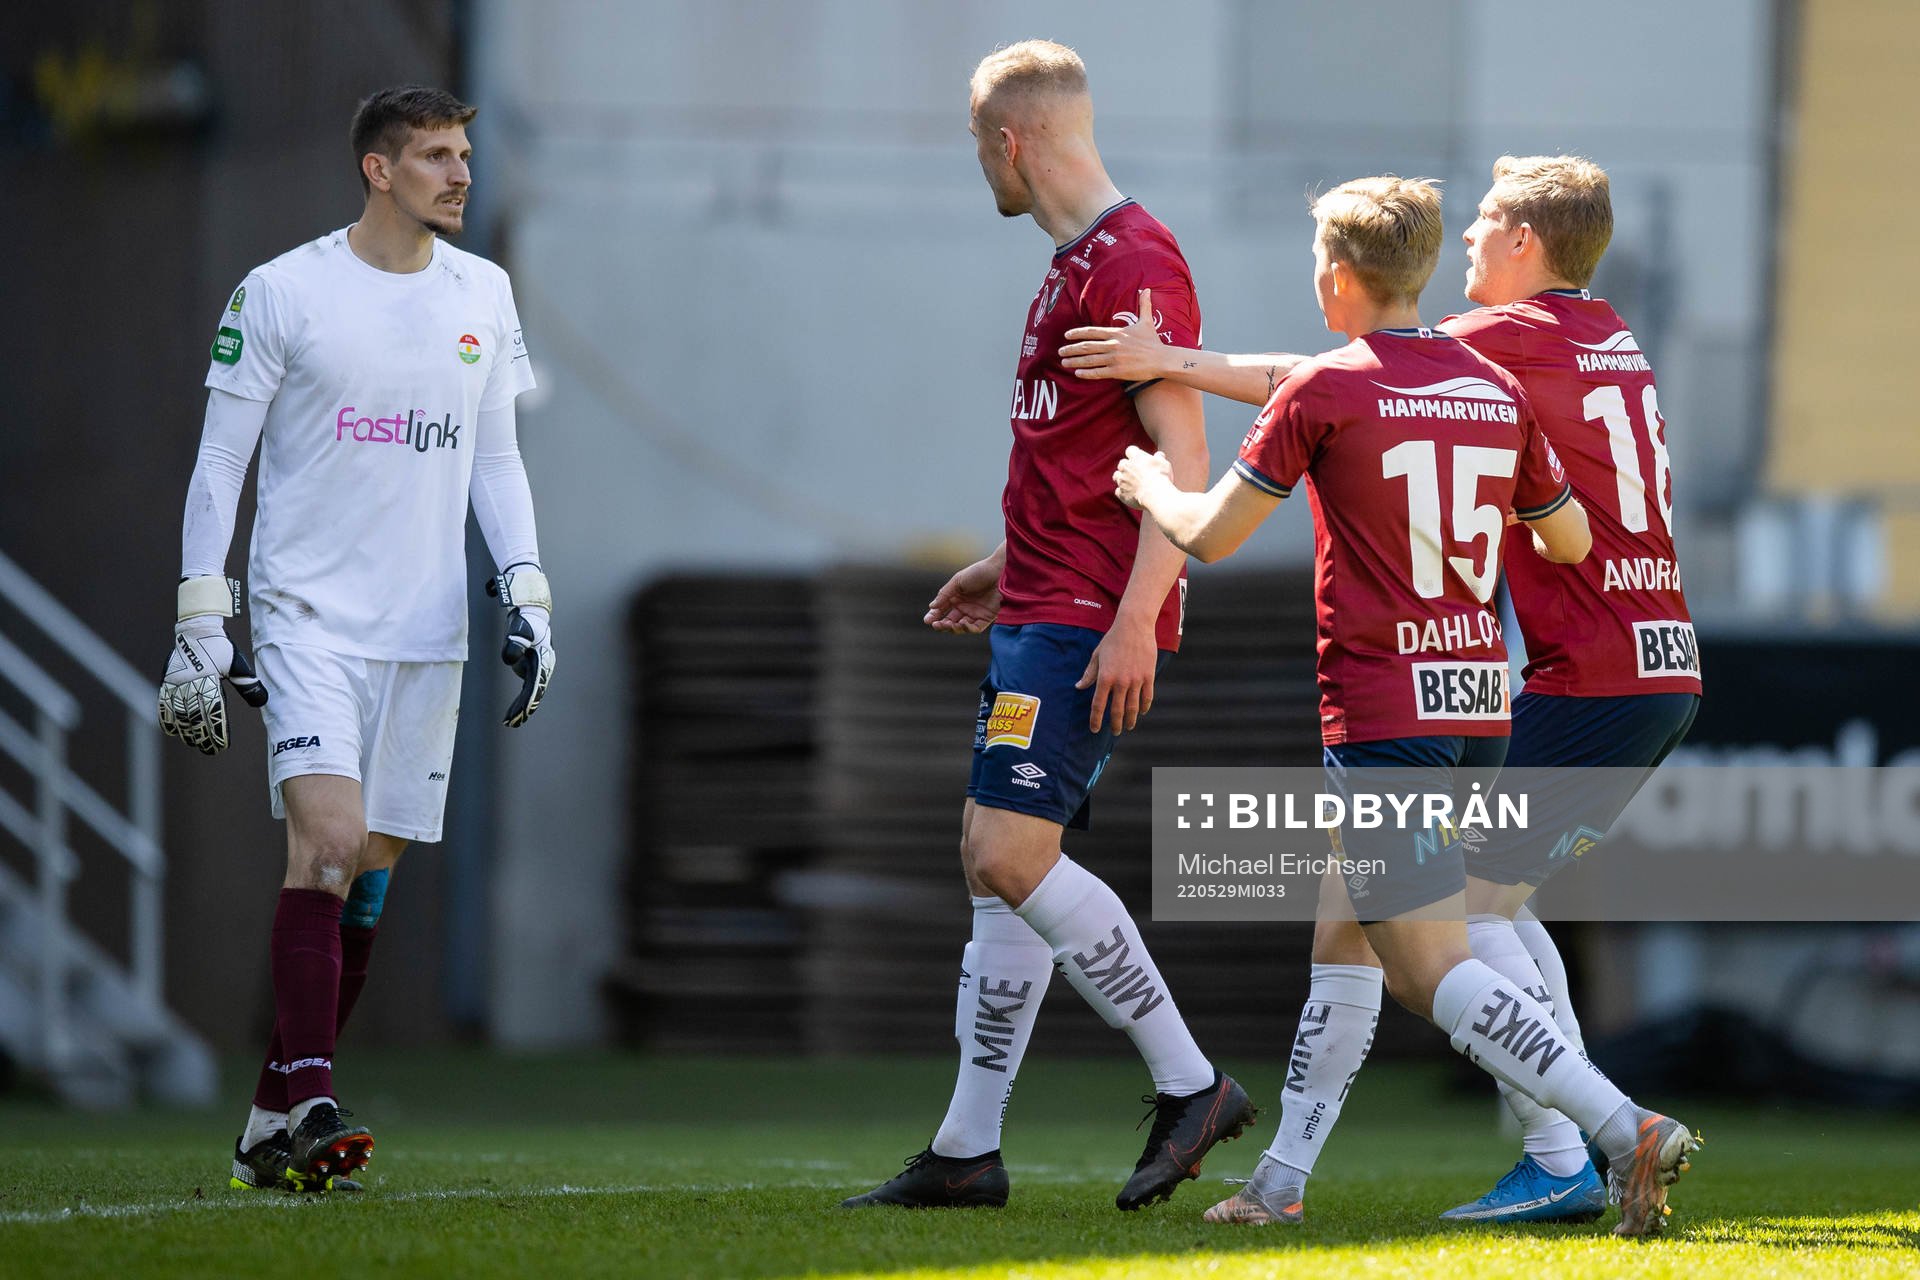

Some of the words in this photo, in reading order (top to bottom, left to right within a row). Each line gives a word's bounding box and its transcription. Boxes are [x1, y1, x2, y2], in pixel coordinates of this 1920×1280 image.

[1378, 399, 1518, 425] HAMMARVIKEN
[1382, 440, 1518, 604] 15
[272, 735, 321, 757] LEGEA
[1011, 777, 1041, 790] umbro
[1072, 925, 1165, 1021] MIKE
[971, 975, 1032, 1073] MIKE
[1285, 1004, 1332, 1094] MIKE
[1472, 988, 1566, 1077] MIKE
[286, 1057, 331, 1075] LEGEA
[1302, 1101, 1326, 1140] umbro
